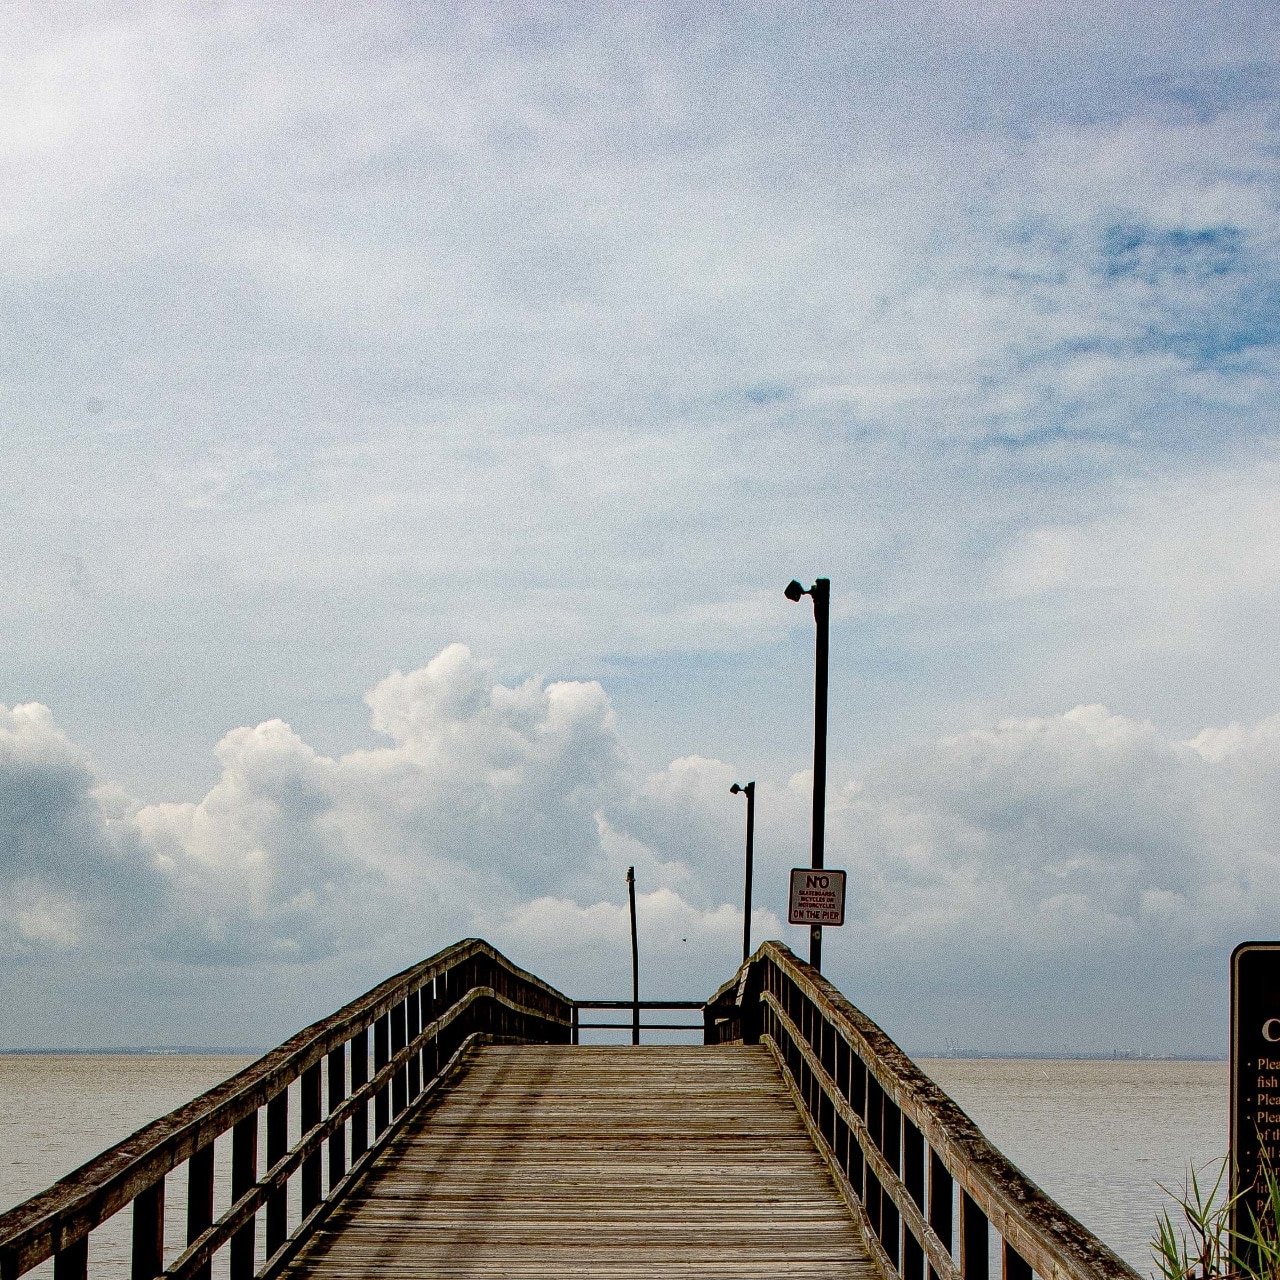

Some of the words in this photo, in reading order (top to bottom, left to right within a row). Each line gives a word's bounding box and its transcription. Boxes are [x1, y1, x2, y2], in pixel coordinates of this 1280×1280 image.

[806, 875, 830, 889] NO
[793, 909, 805, 918] ON
[806, 910, 821, 920] THE
[822, 911, 840, 920] PIER
[1257, 1075, 1278, 1088] fish
[1256, 1128, 1271, 1141] of
[1256, 1146, 1275, 1159] All
